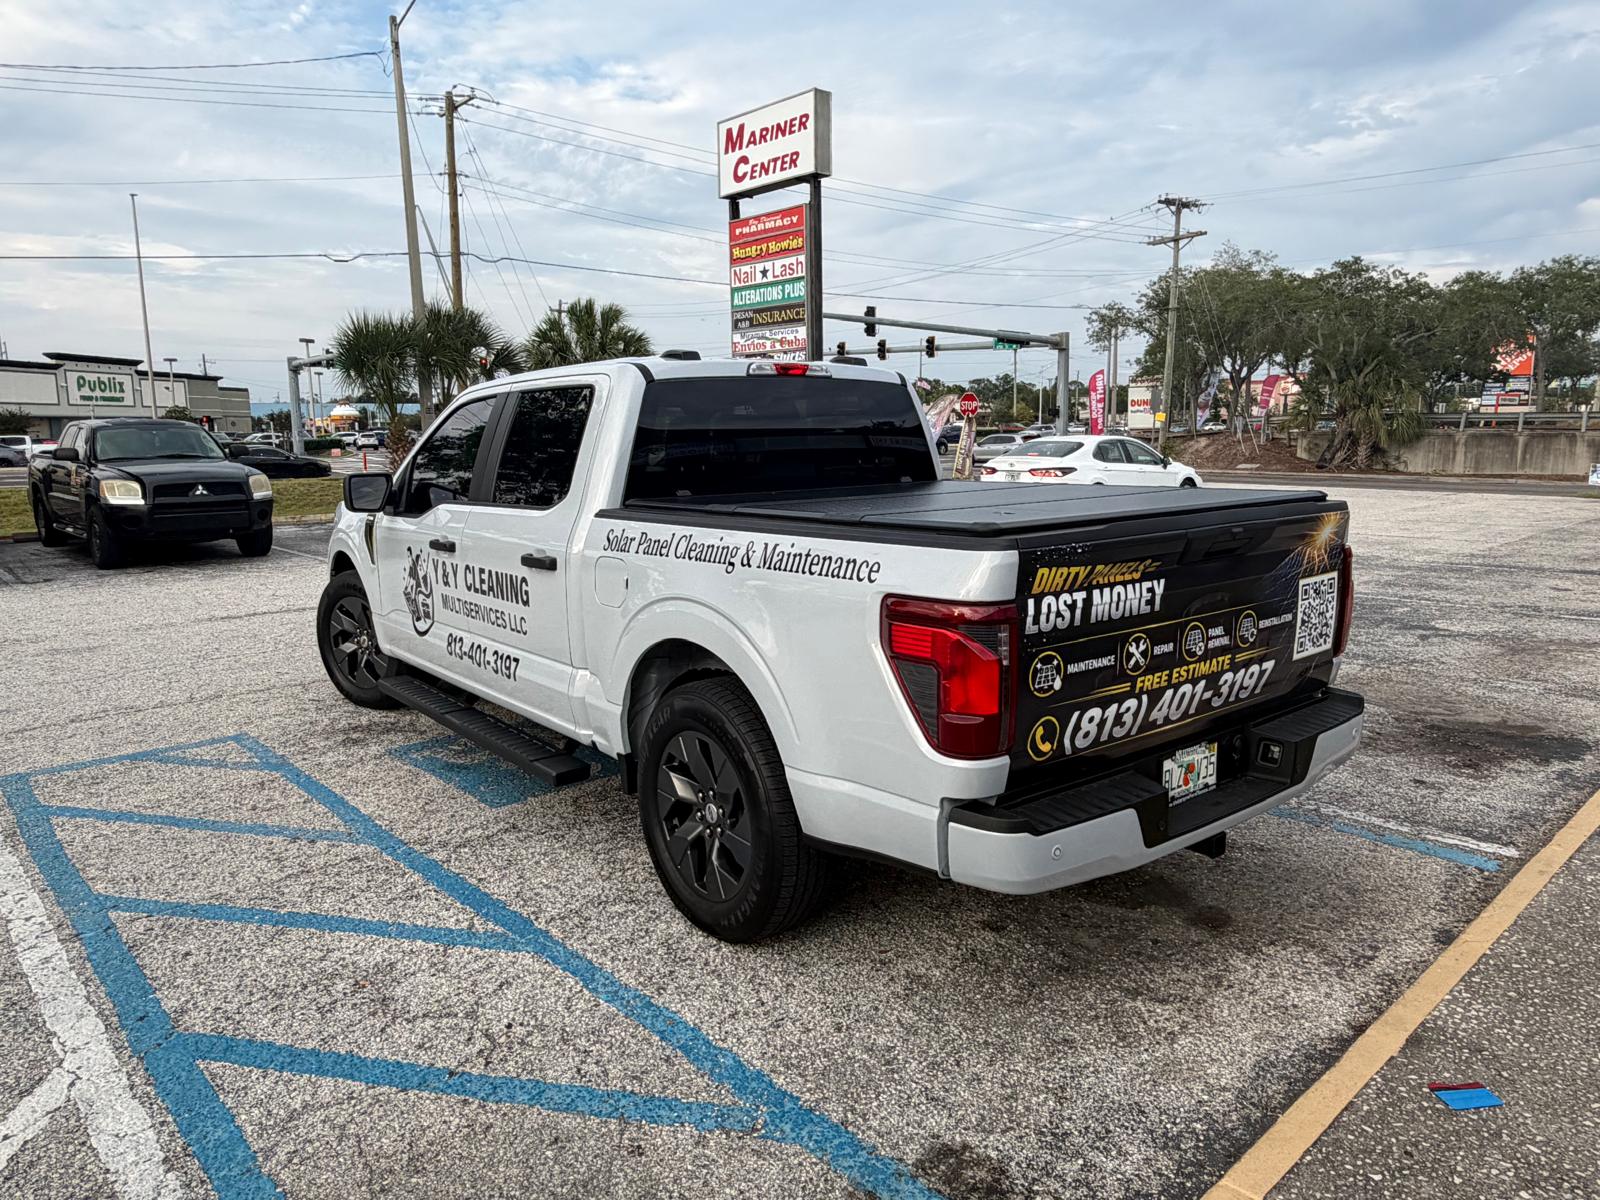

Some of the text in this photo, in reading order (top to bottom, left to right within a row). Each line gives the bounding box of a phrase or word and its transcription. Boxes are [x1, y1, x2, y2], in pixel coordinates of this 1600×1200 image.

[724, 113, 810, 155] MARINER
[733, 151, 800, 183] CENTER
[735, 215, 799, 235] PHARMACY
[732, 236, 804, 259] Hungry Howie's
[733, 257, 804, 286] Nail Lash
[733, 281, 805, 306] ALTERATIONS PLUS
[753, 308, 806, 325] INSURANCE
[768, 328, 799, 337] Services
[780, 336, 807, 348] Cuba
[77, 375, 125, 393] Publix
[961, 401, 978, 410] STOP
[1096, 374, 1105, 430] DRIVE THRU
[603, 528, 881, 583] Solar Panel Cleaning & Maintenance
[432, 558, 530, 608] Y & Y CLEANING
[1031, 565, 1091, 595] DIRTY
[441, 593, 507, 630] MULTISERVICES
[508, 612, 528, 636] LLC
[1025, 578, 1166, 635] LOST MONEY
[1208, 626, 1225, 638] PANEL
[446, 633, 520, 682] 813-401-3197
[1153, 642, 1174, 656] REPAIR
[1067, 655, 1116, 674] MAINTENANCE
[1135, 655, 1231, 694] FREE ESTIMATE
[1063, 660, 1276, 756] (813) 401-3197
